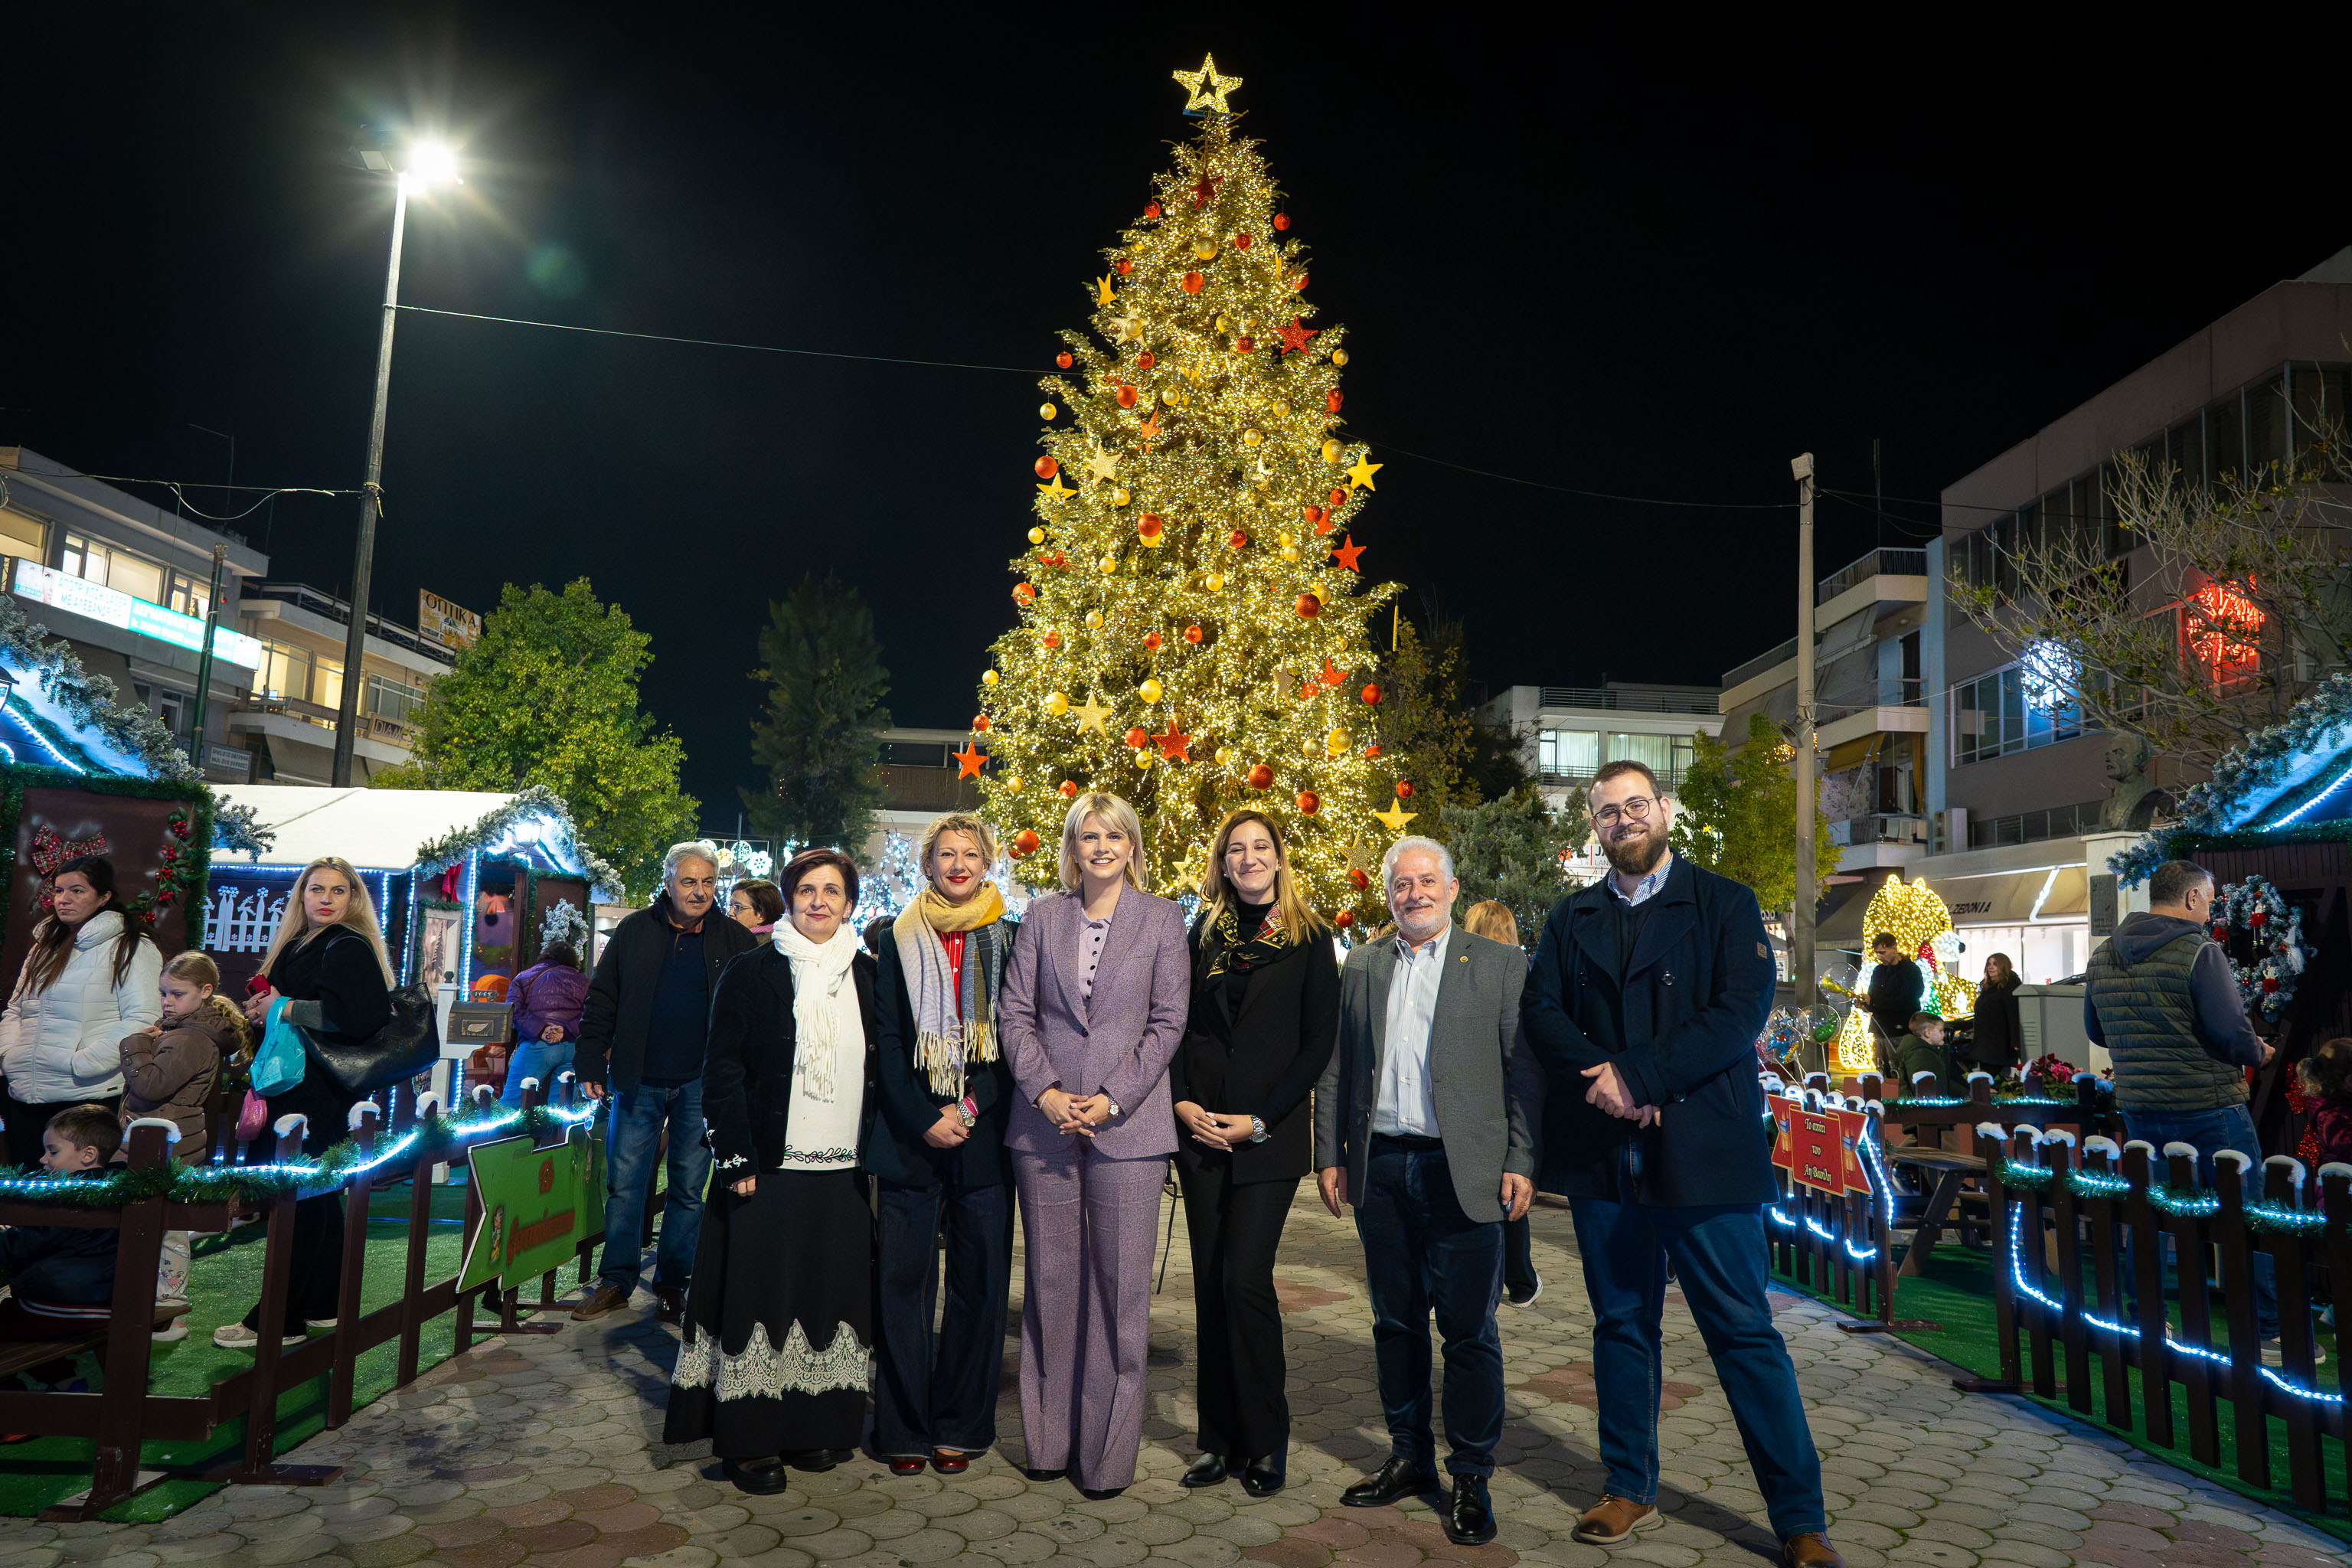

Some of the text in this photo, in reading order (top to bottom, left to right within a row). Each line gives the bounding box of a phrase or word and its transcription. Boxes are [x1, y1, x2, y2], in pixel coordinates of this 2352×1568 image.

[426, 593, 476, 628] ΟΠΤΙΚΑ
[1805, 1117, 1811, 1131] Το
[1811, 1145, 1821, 1156] του
